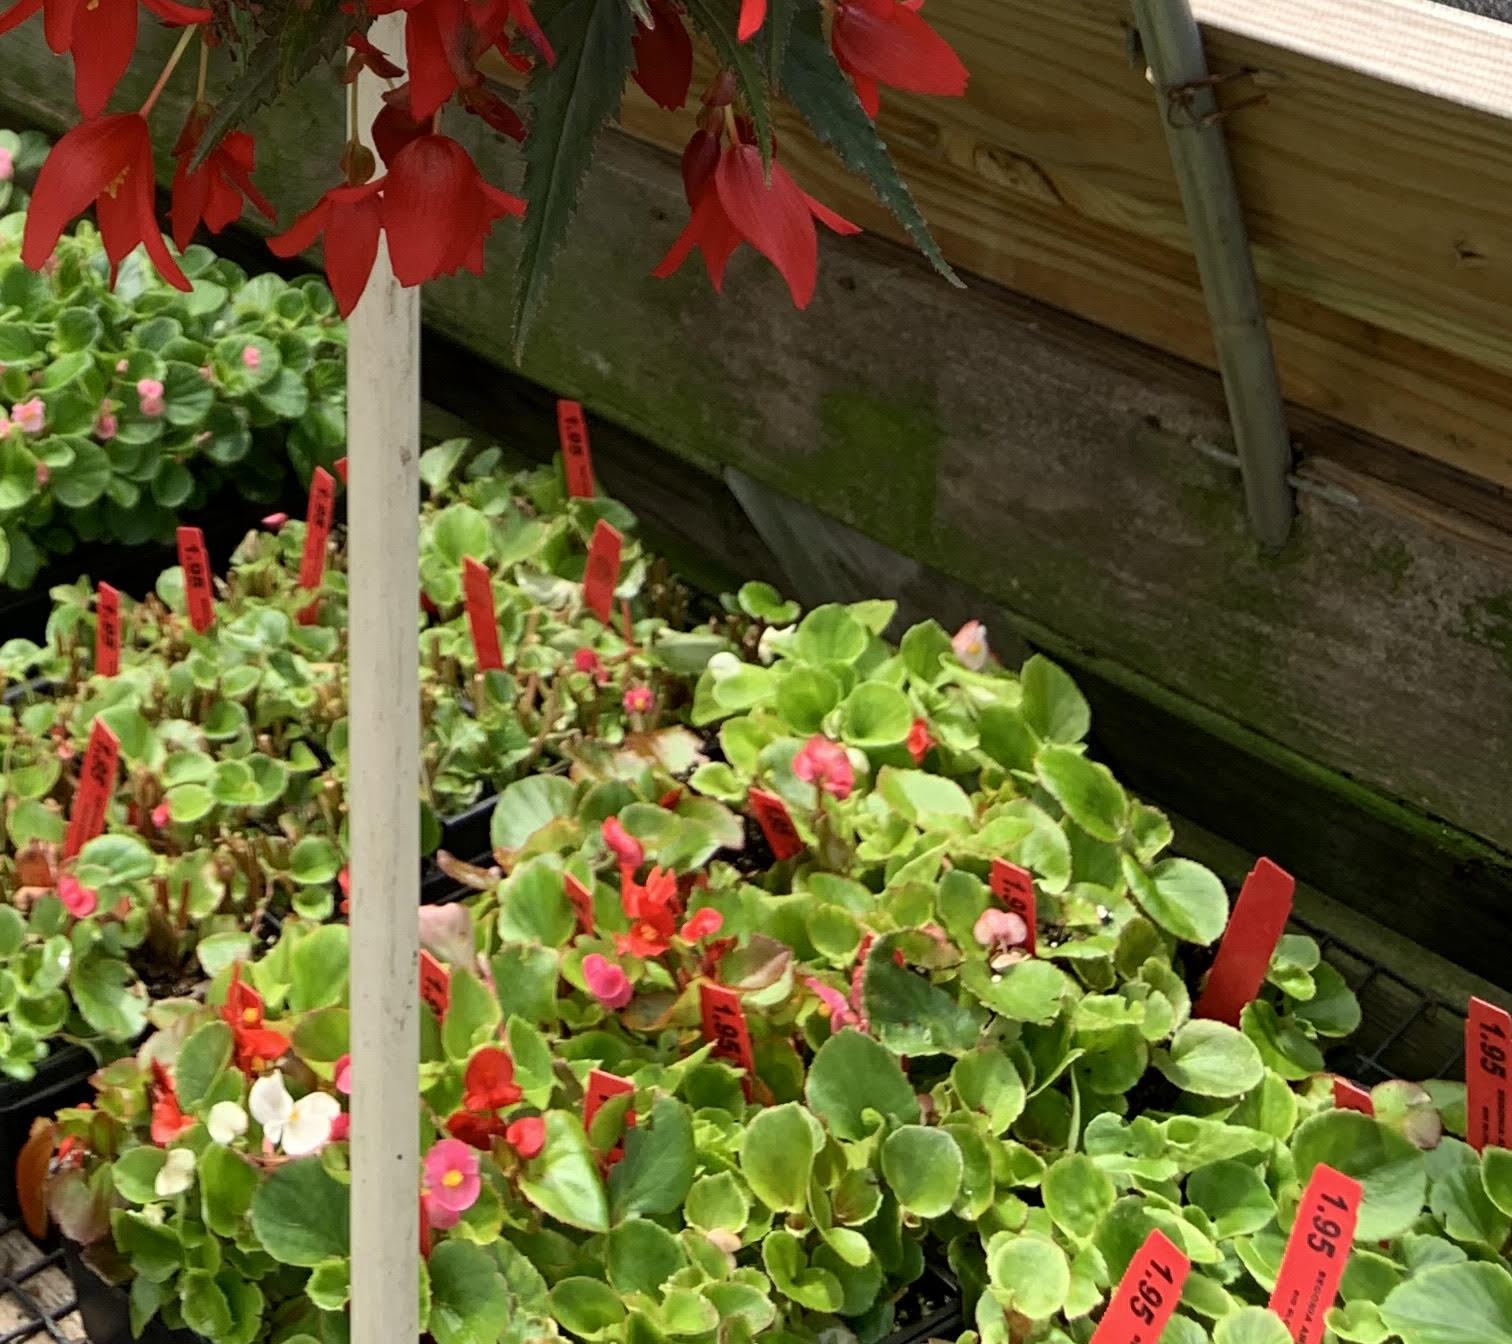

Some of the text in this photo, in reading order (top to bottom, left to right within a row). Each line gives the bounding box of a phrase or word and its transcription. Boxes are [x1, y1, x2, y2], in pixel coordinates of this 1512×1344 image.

[1480, 1021, 1506, 1079] 1.95
[1307, 1193, 1349, 1259] 1.95
[1130, 1259, 1174, 1326] 1.95
